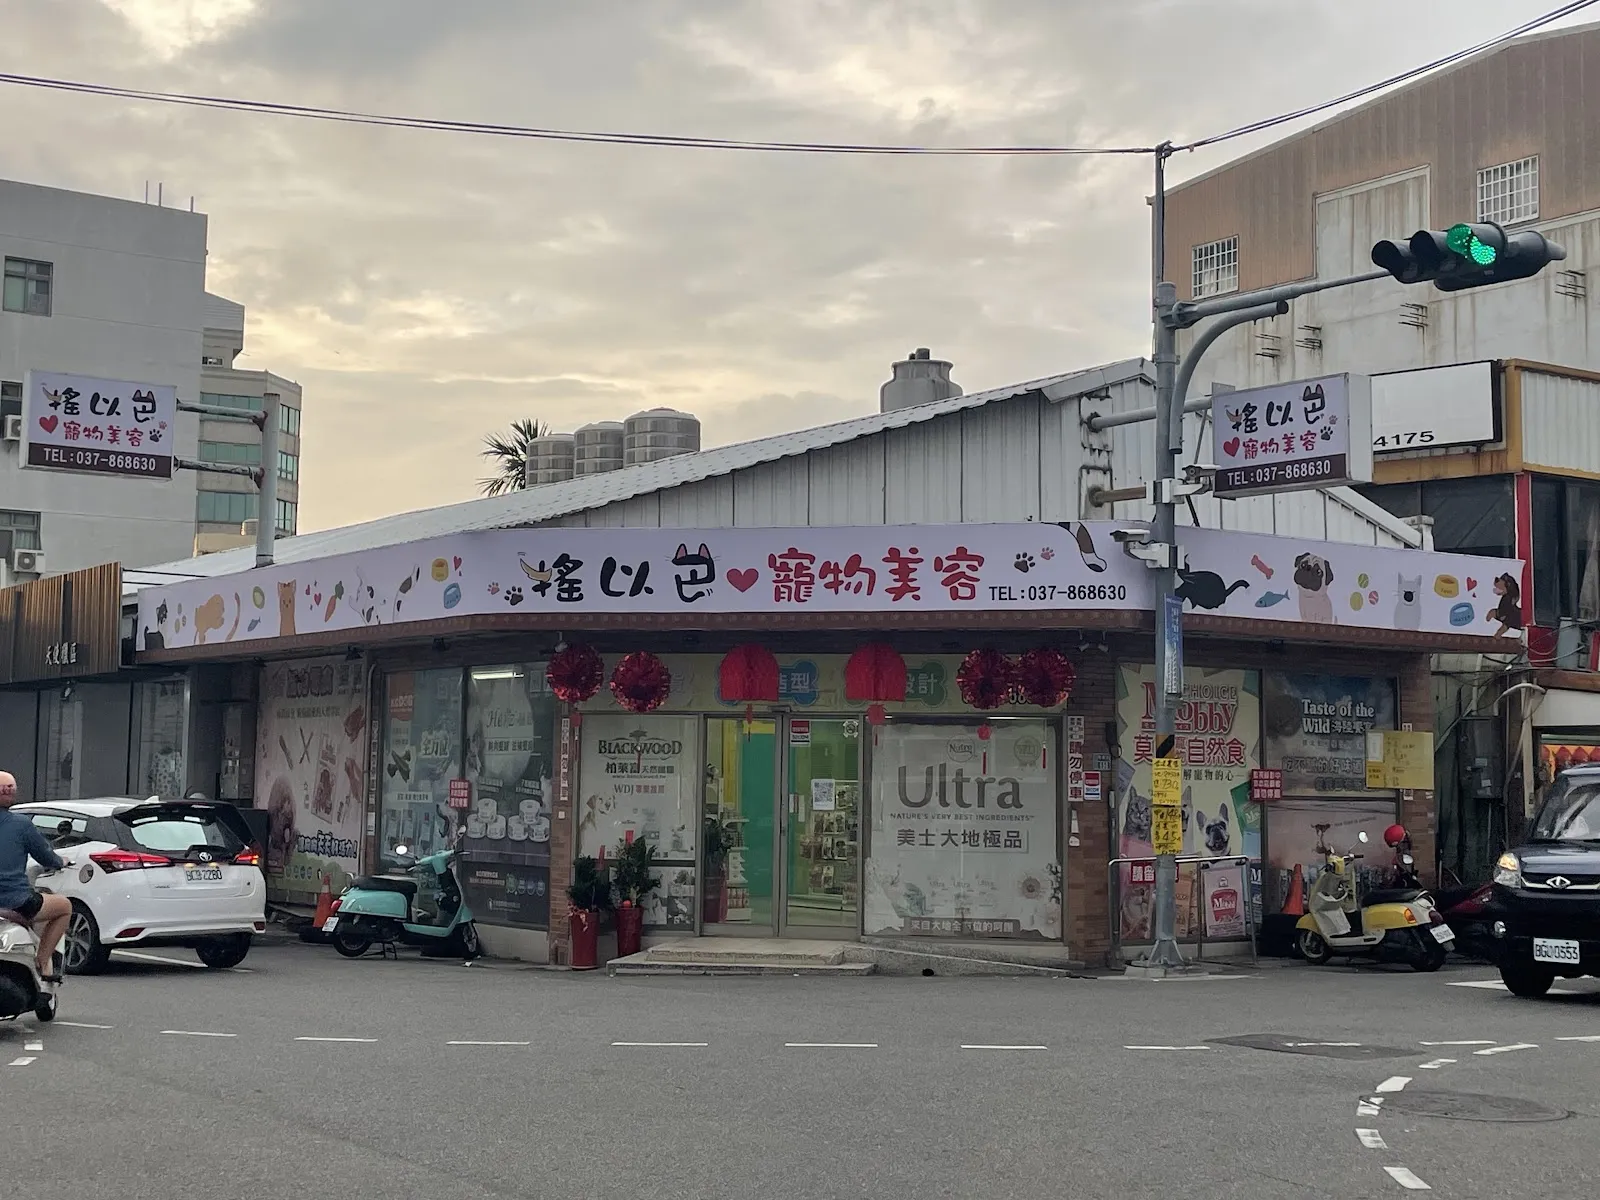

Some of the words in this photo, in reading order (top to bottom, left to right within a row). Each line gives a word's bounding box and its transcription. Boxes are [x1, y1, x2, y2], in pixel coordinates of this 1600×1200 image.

[63, 420, 144, 447] 寵物美容
[1373, 430, 1434, 447] 4175
[1242, 430, 1317, 460] 寵物美容
[43, 447, 156, 472] TEL:037-868630
[1227, 459, 1331, 486] TEL:037-868630
[768, 545, 985, 602] 寵物美容
[989, 585, 1126, 601] TEL:037-868630
[1302, 698, 1336, 716] Taste
[1340, 701, 1353, 717] of
[1356, 703, 1374, 718] the
[1302, 718, 1331, 733] Wild
[598, 740, 683, 755] BLACKWOOD
[614, 784, 634, 794] WDJ
[898, 763, 1024, 809] Ultra
[890, 812, 928, 820] NATURE'S
[896, 828, 1022, 848] 美士大地極品
